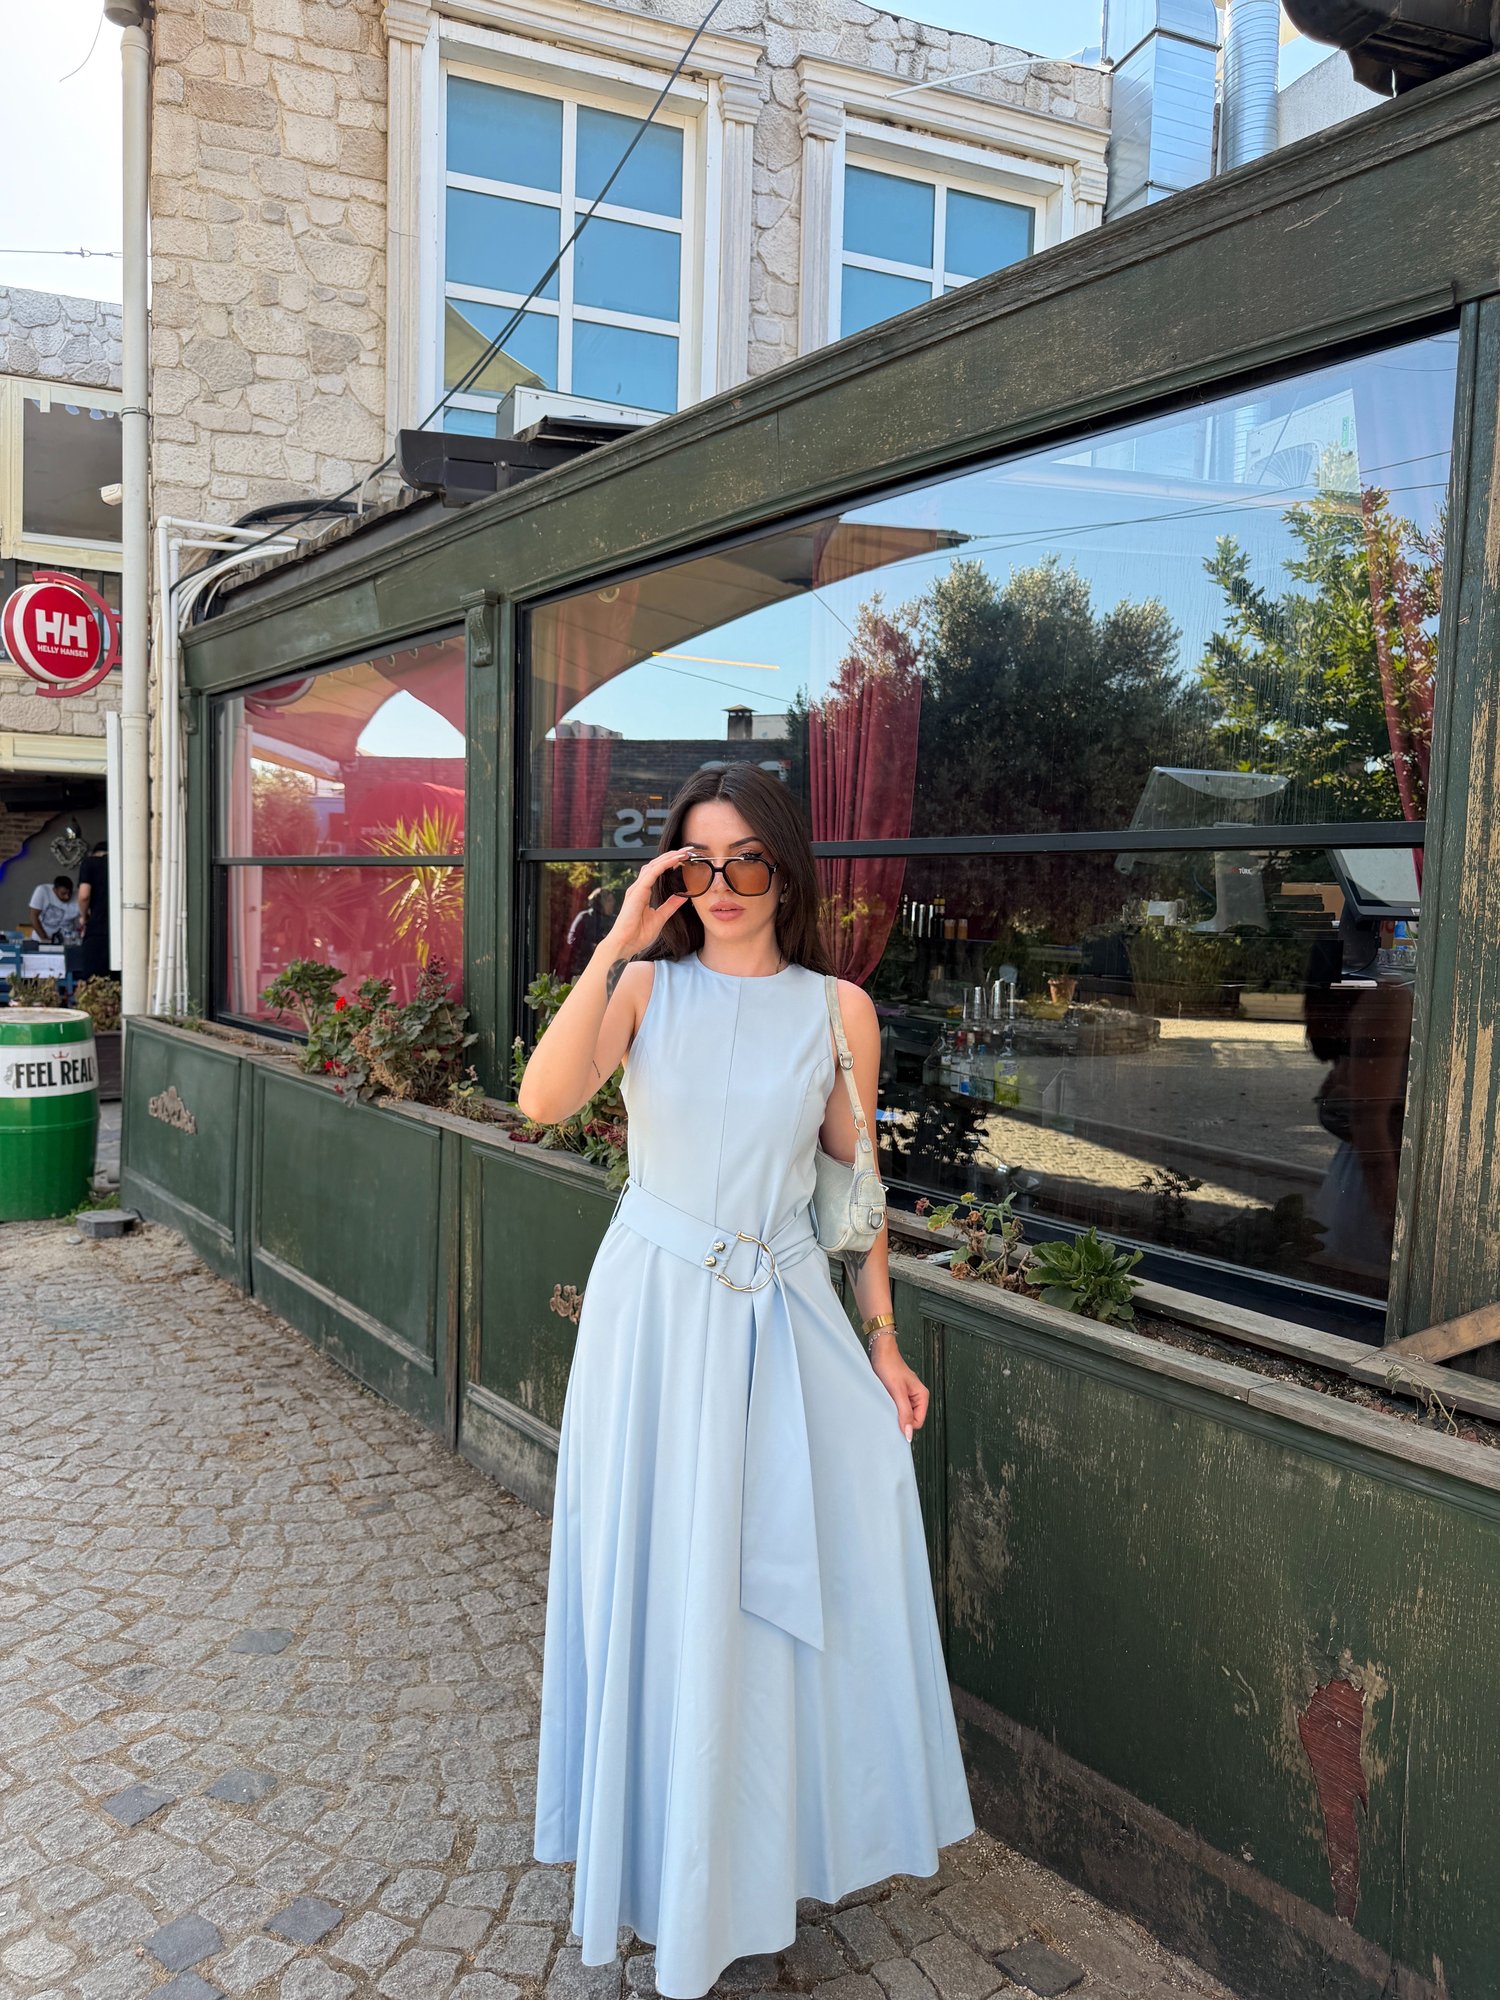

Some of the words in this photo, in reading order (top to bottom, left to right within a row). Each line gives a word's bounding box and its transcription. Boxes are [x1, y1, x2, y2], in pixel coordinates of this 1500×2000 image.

[35, 608, 88, 649] HH
[37, 644, 59, 655] HELLY
[60, 647, 89, 658] HANSEN
[15, 1061, 57, 1089] FEEL
[60, 1056, 94, 1086] REAL
